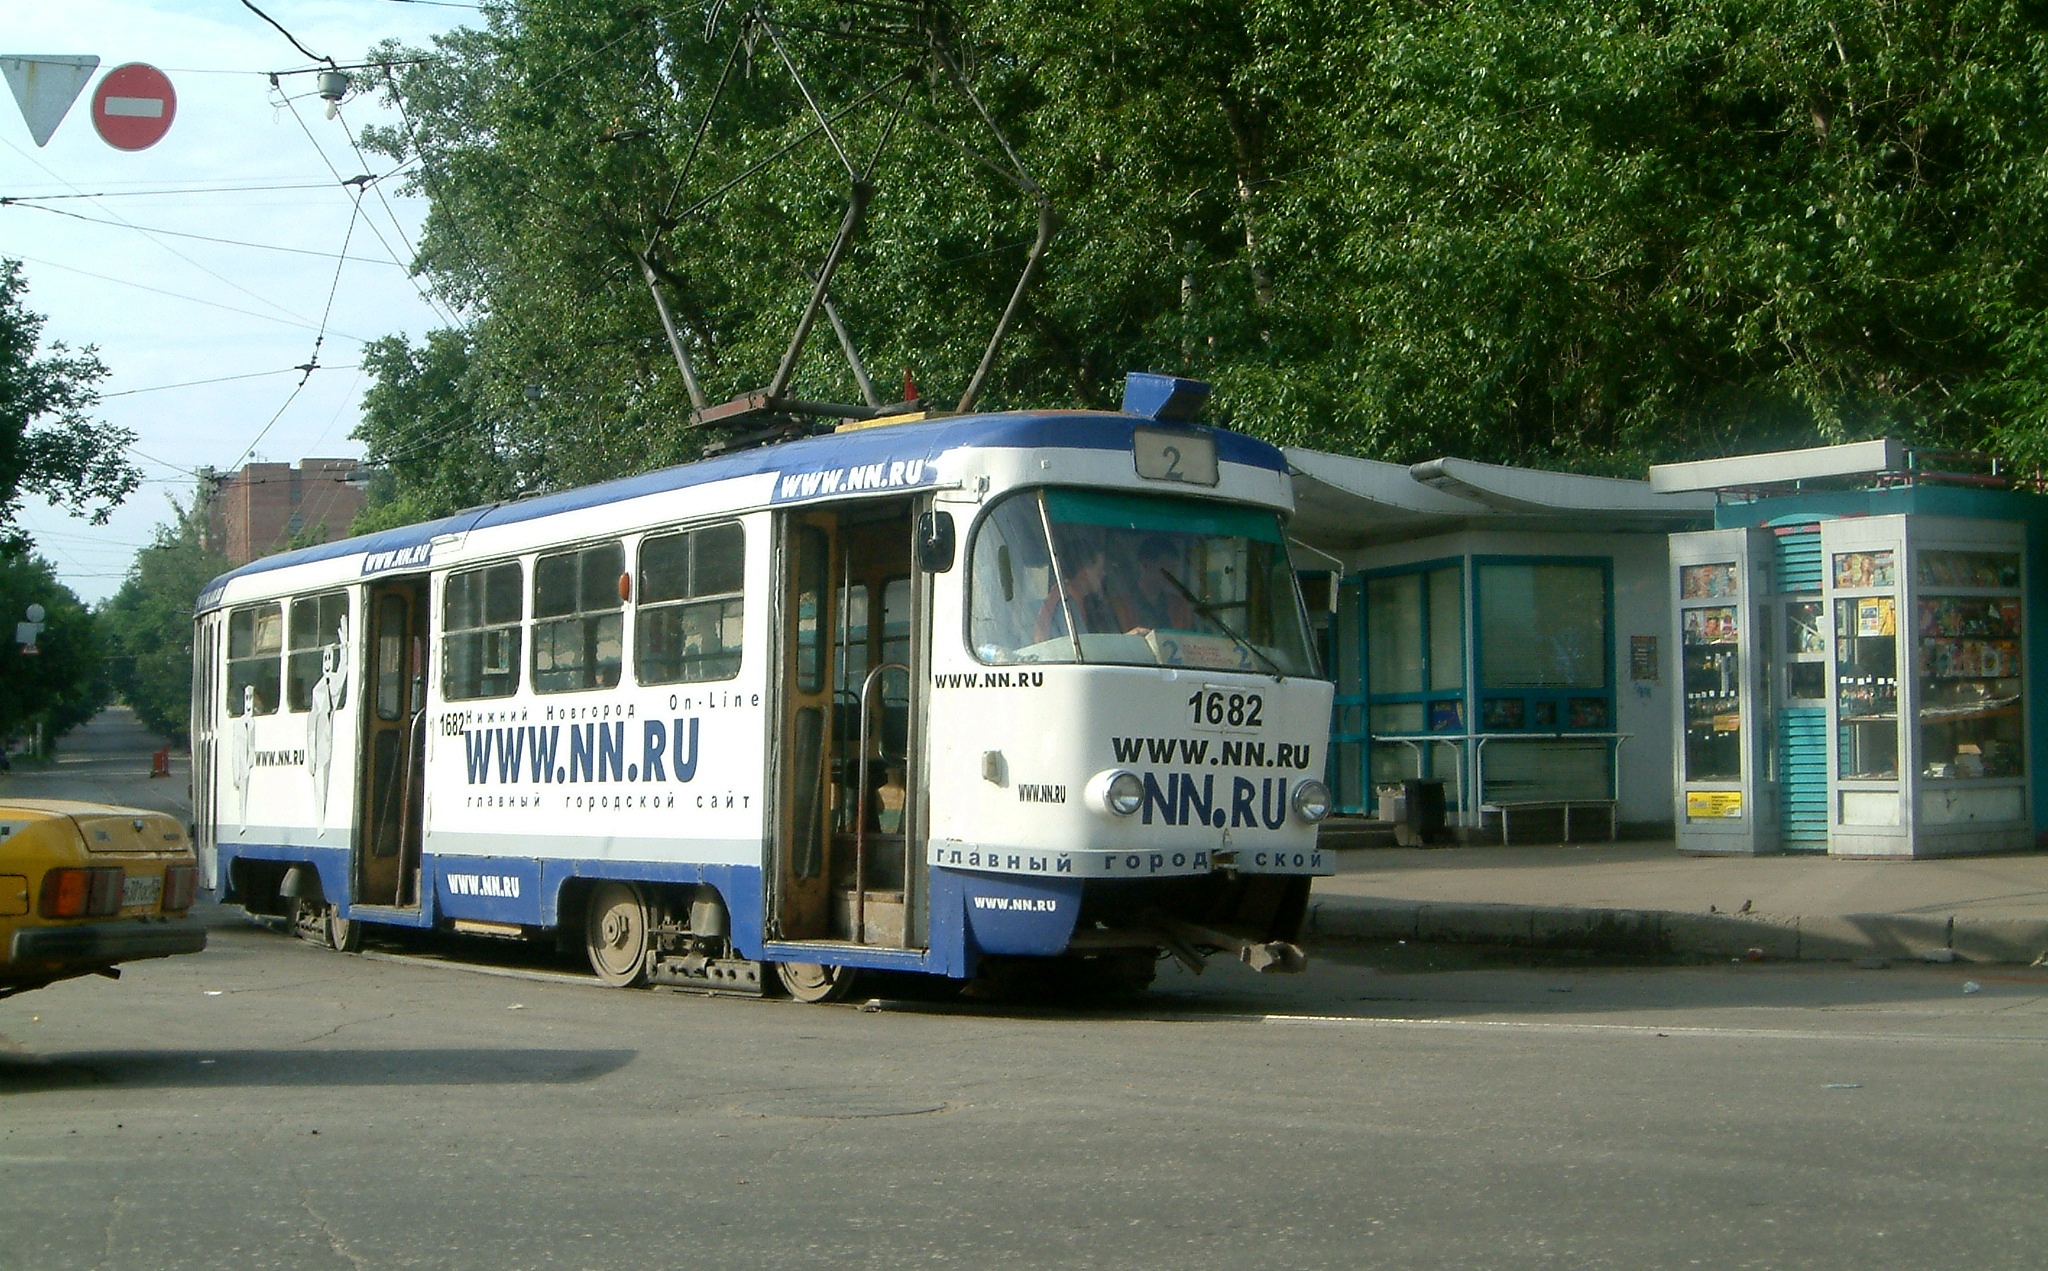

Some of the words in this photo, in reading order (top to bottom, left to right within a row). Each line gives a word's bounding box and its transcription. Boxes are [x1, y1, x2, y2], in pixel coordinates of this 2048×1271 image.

[1162, 446, 1183, 481] 2
[781, 458, 924, 500] WWW.NN.RU
[365, 544, 430, 572] WWW.NN.RU
[1162, 640, 1182, 665] 2
[1233, 645, 1252, 669] 2
[935, 672, 1044, 689] WWW.NN.RU
[465, 707, 528, 724] Нижний
[546, 703, 635, 720] Новгород
[1188, 691, 1263, 728] 1682
[439, 712, 465, 737] 1682
[255, 749, 305, 767] WWW.NN.RU
[465, 717, 700, 785] WWW.NN.RU
[1112, 736, 1311, 769] WWW.NN.RU
[467, 792, 541, 808] главный
[565, 792, 675, 812] городской
[696, 790, 751, 809] сайт
[1018, 783, 1066, 804] WWW.NN.RU
[1141, 771, 1288, 830] NN.RU
[936, 847, 1072, 873] главный
[447, 873, 521, 899] WWW.NN.RU
[973, 896, 1057, 912] WWW.NN.RU
